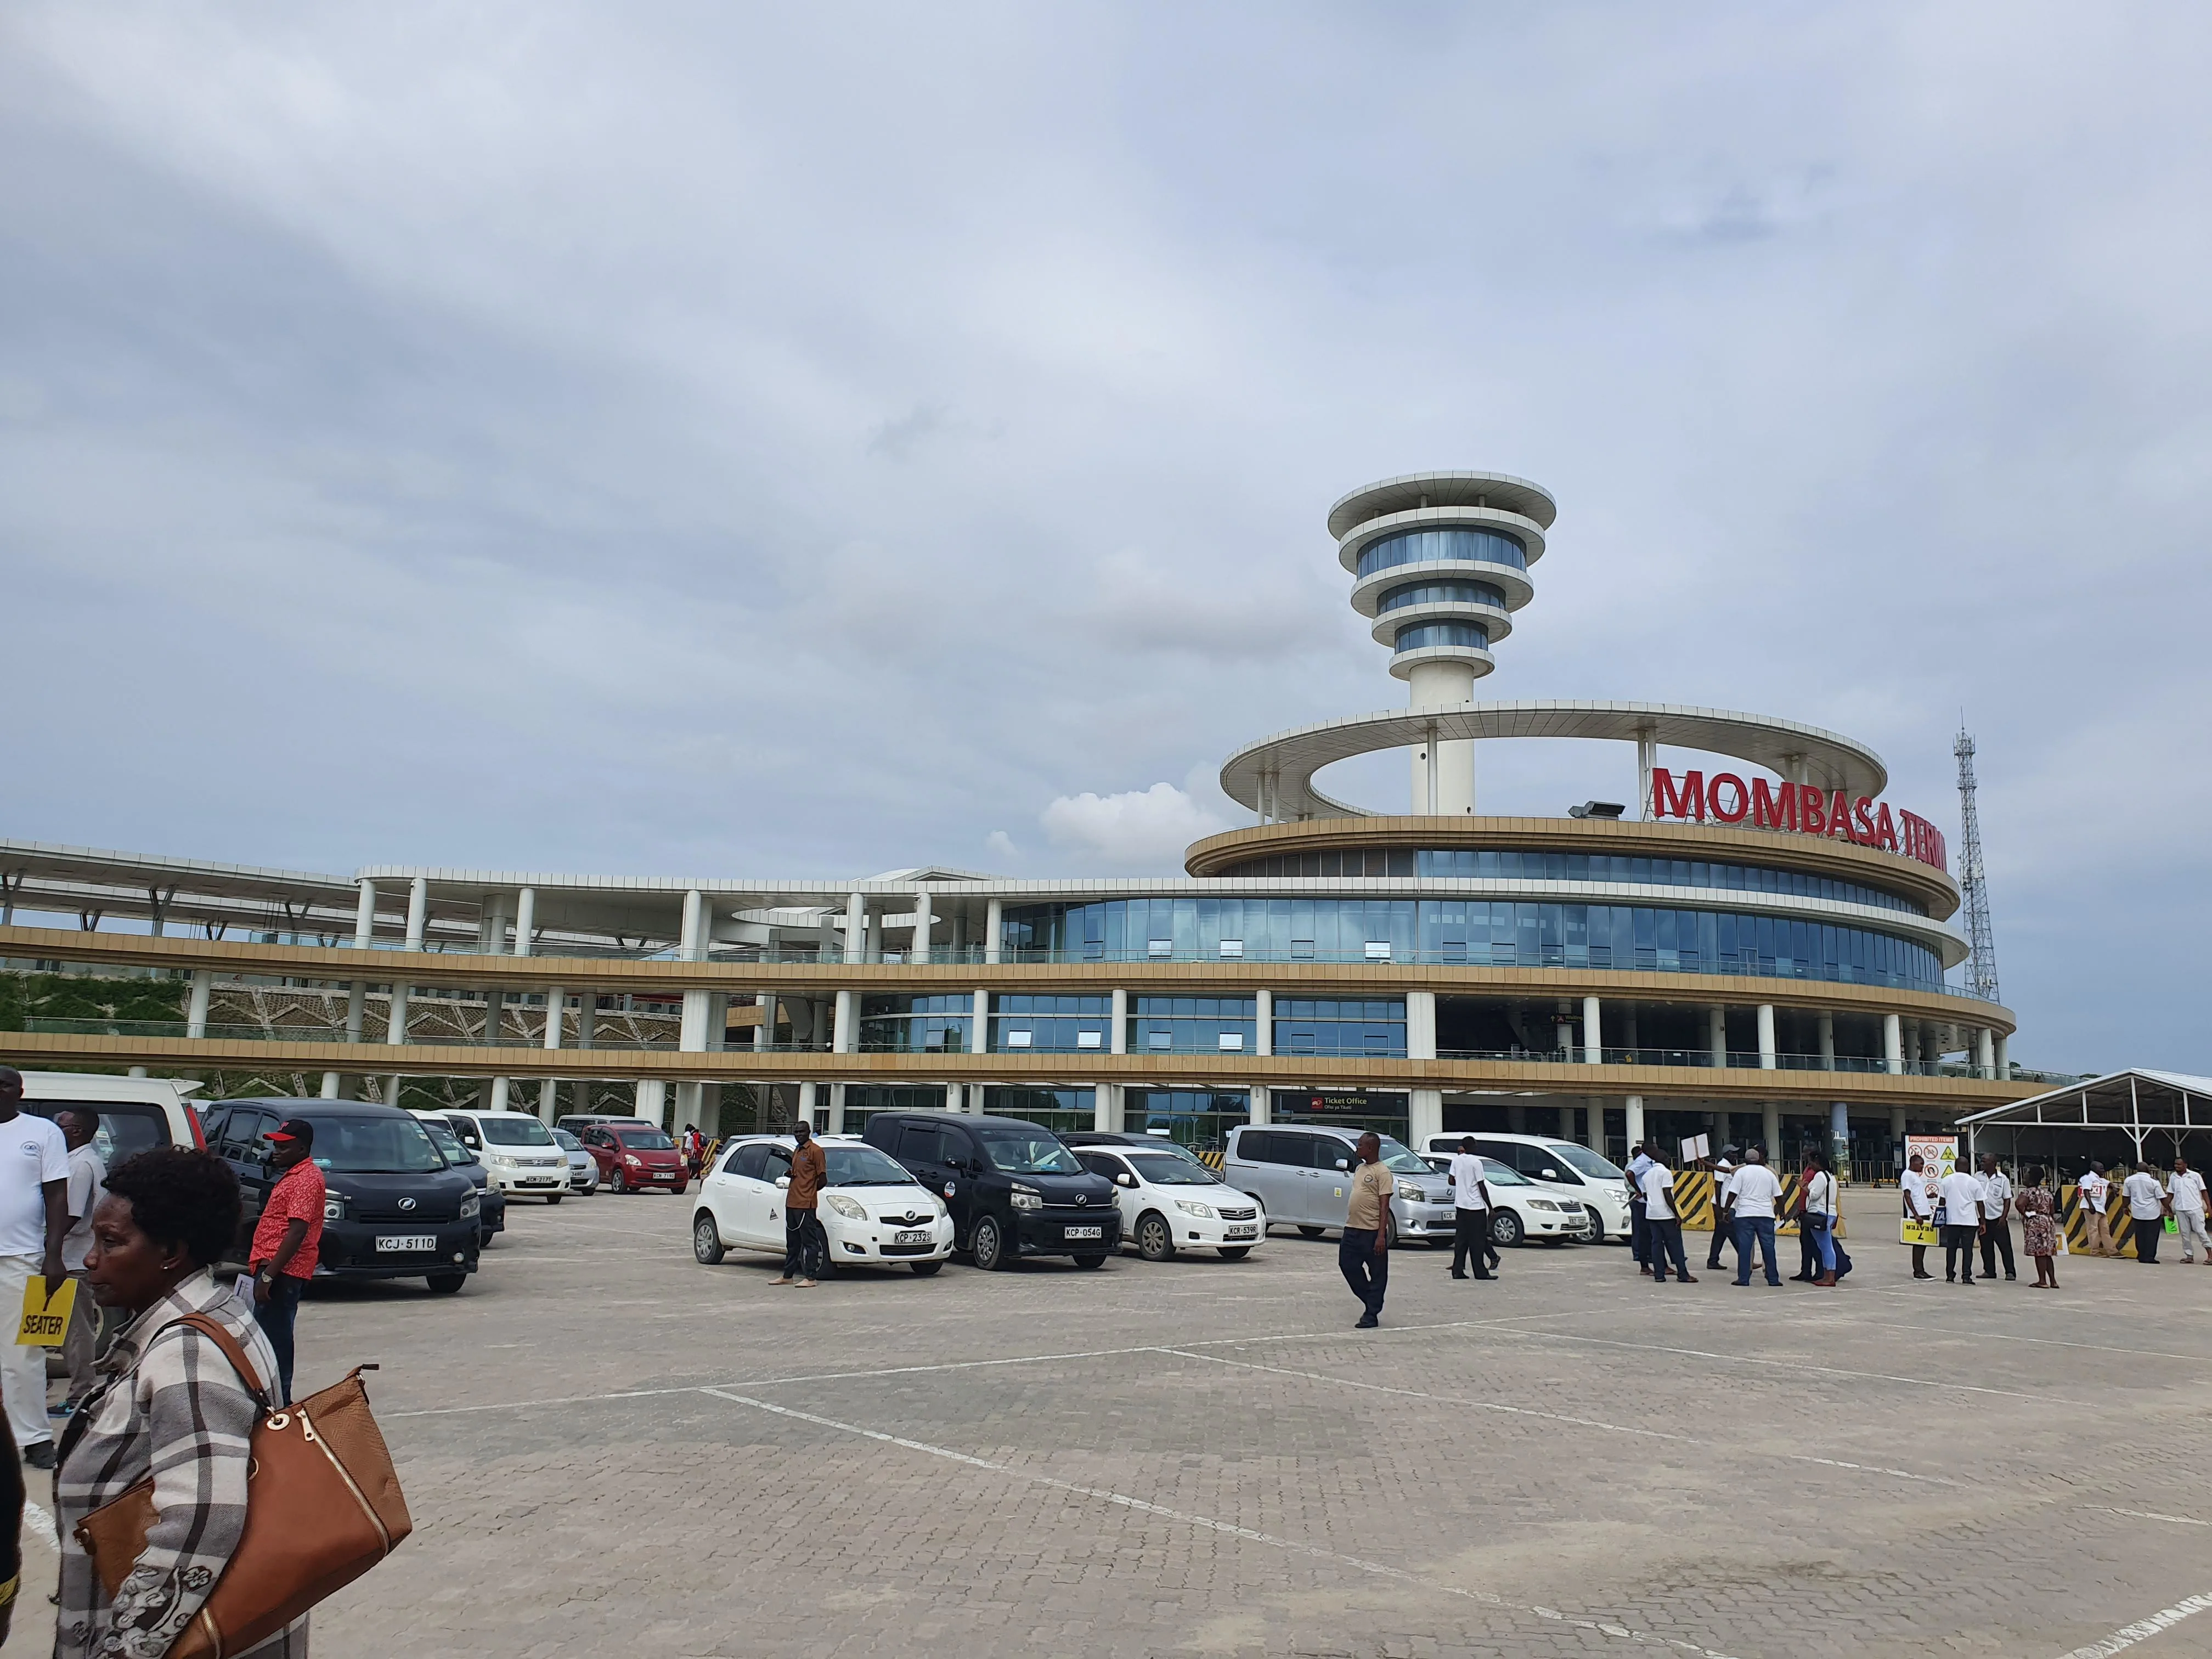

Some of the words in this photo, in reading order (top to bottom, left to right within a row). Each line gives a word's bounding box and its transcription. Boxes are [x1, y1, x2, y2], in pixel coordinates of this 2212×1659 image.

[1652, 768, 1898, 851] MOMBASA
[895, 1233, 909, 1243] KCP
[912, 1232, 930, 1242] 232S
[1066, 1228, 1079, 1237] KCP
[1083, 1228, 1101, 1237] 054G
[379, 1239, 400, 1249] KCJ
[406, 1238, 434, 1249] 511D
[23, 1314, 64, 1335] SEATER
